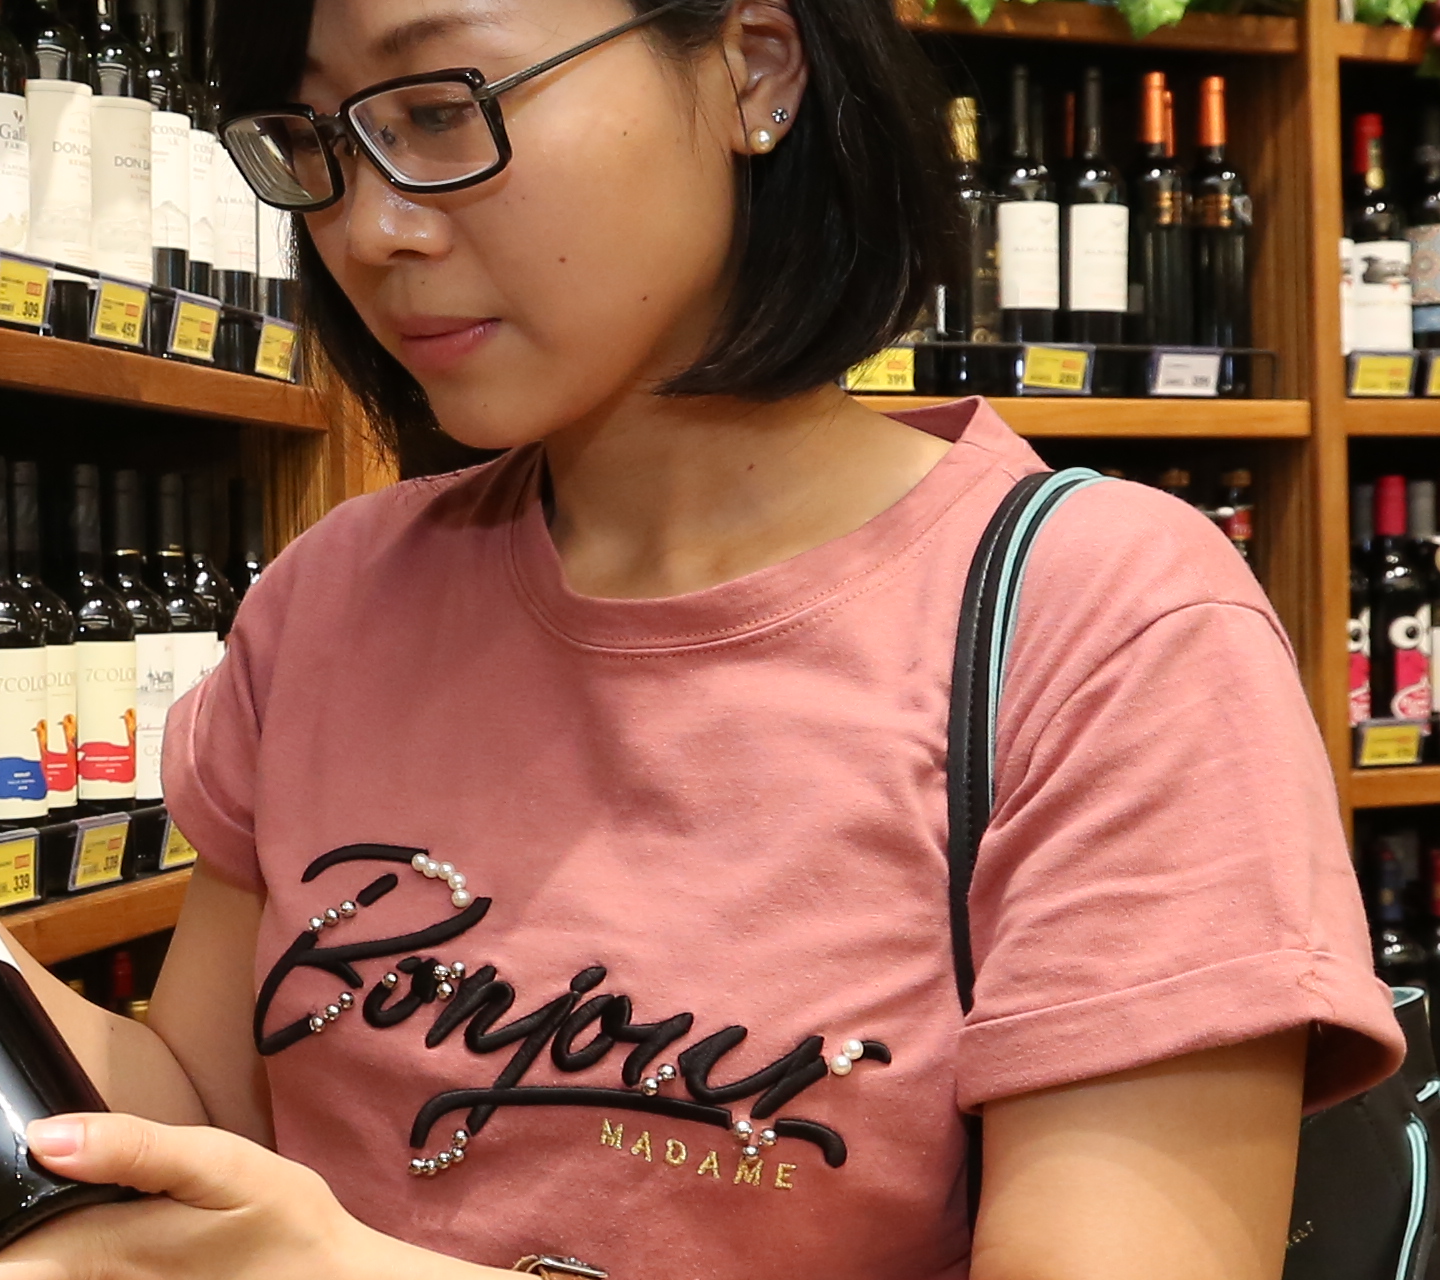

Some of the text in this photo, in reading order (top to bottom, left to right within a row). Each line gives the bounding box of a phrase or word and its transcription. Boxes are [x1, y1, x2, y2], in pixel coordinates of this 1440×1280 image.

[13, 874, 31, 892] 339
[253, 841, 891, 1176] Bonjour
[600, 1120, 795, 1190] MADAME
